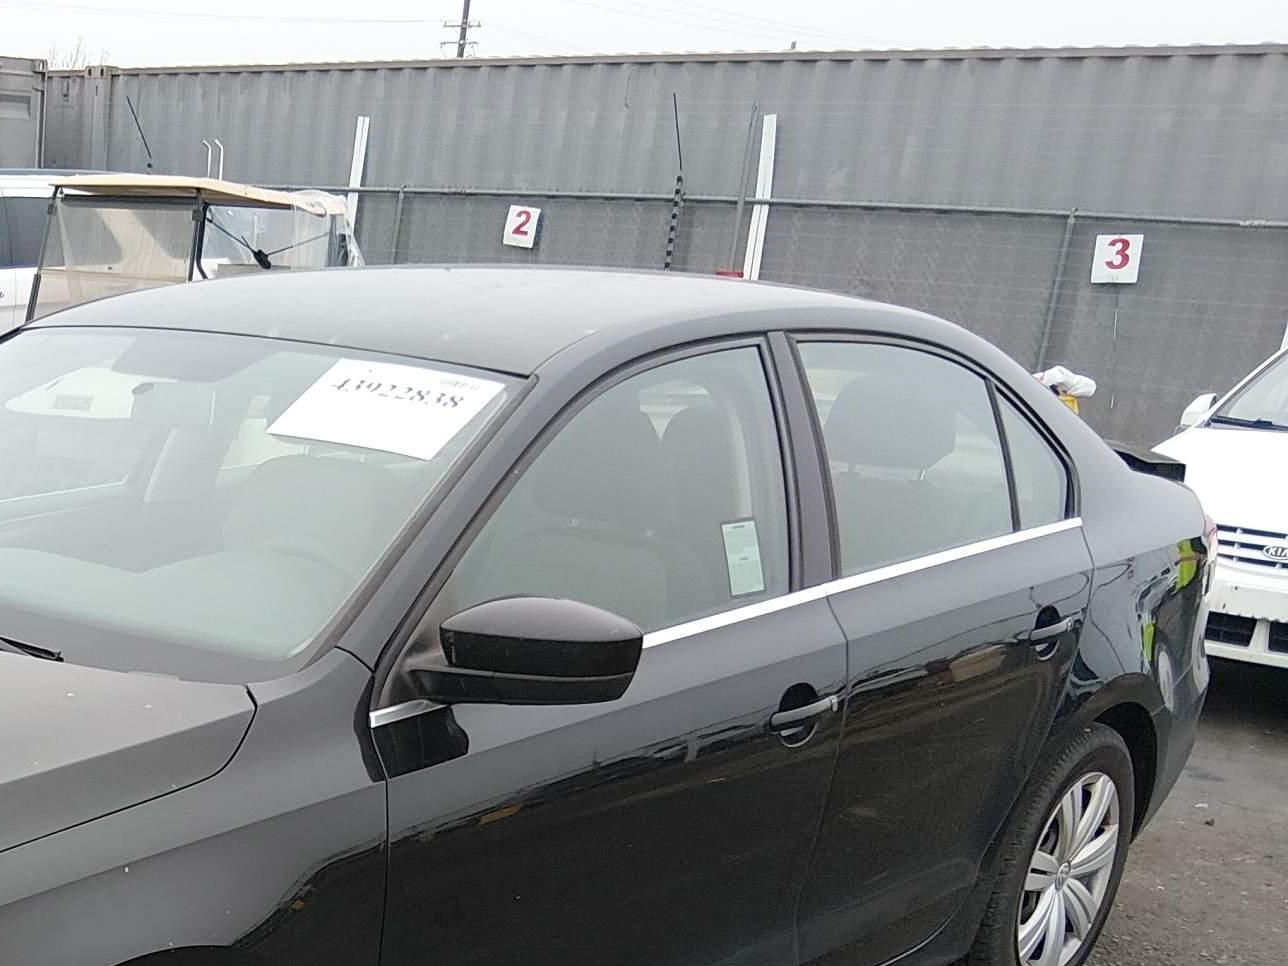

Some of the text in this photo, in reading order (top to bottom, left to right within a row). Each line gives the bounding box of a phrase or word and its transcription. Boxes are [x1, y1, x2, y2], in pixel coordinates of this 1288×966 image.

[512, 210, 532, 236] 2
[1104, 238, 1130, 270] 3
[332, 377, 464, 409] 43922838
